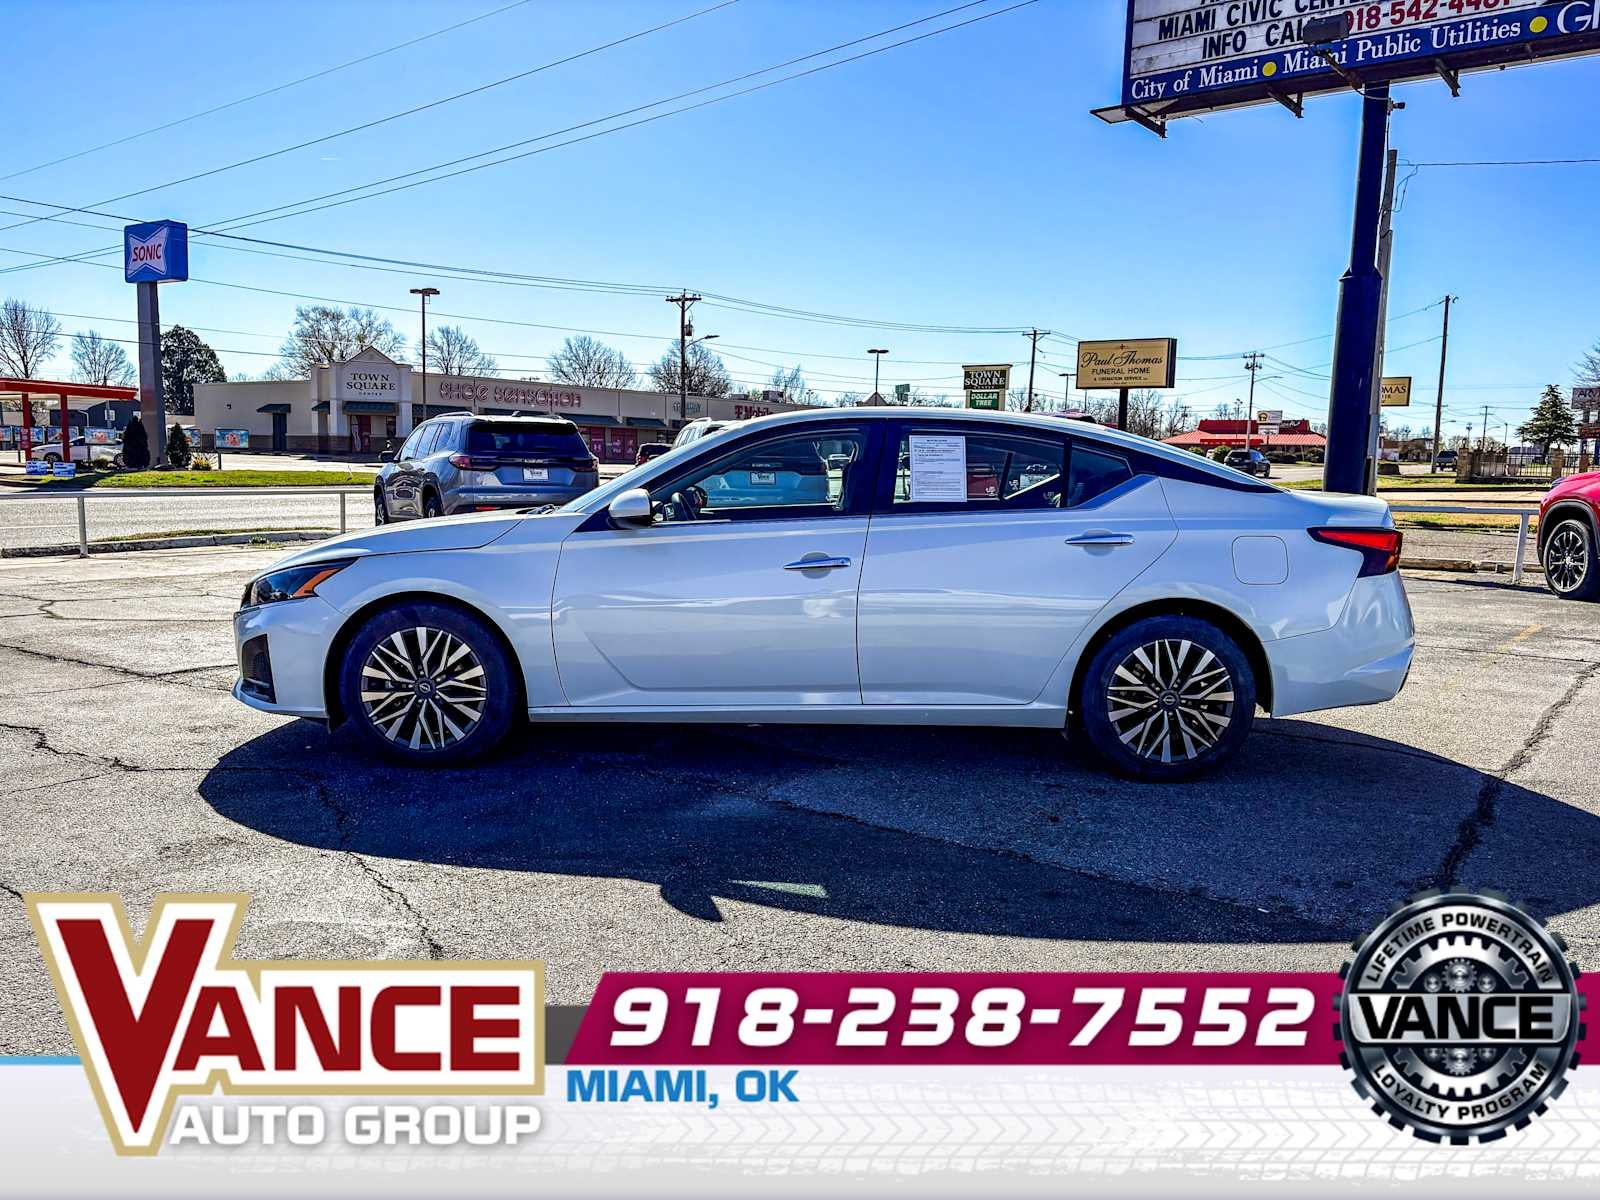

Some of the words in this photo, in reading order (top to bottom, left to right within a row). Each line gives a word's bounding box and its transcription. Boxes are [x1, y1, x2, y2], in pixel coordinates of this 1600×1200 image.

[1158, 8, 1217, 41] MIAMI
[1226, 0, 1283, 26] CIVIC
[1202, 30, 1247, 60] INFO
[1131, 78, 1167, 100] City
[1173, 70, 1193, 93] of
[1198, 59, 1259, 88] Miami
[1282, 43, 1347, 74] Miami
[1356, 33, 1422, 61] Public
[1431, 19, 1521, 49] Utilities
[132, 243, 162, 262] SONIC
[1080, 351, 1116, 369] Paul
[1113, 350, 1163, 368] Thomas
[969, 370, 1001, 378] TOWN
[1091, 367, 1125, 375] FUNERAL
[350, 372, 390, 381] TOWN
[346, 381, 397, 391] SQUARE
[964, 377, 1006, 387] SQUARE
[971, 392, 999, 400] DOLLAR
